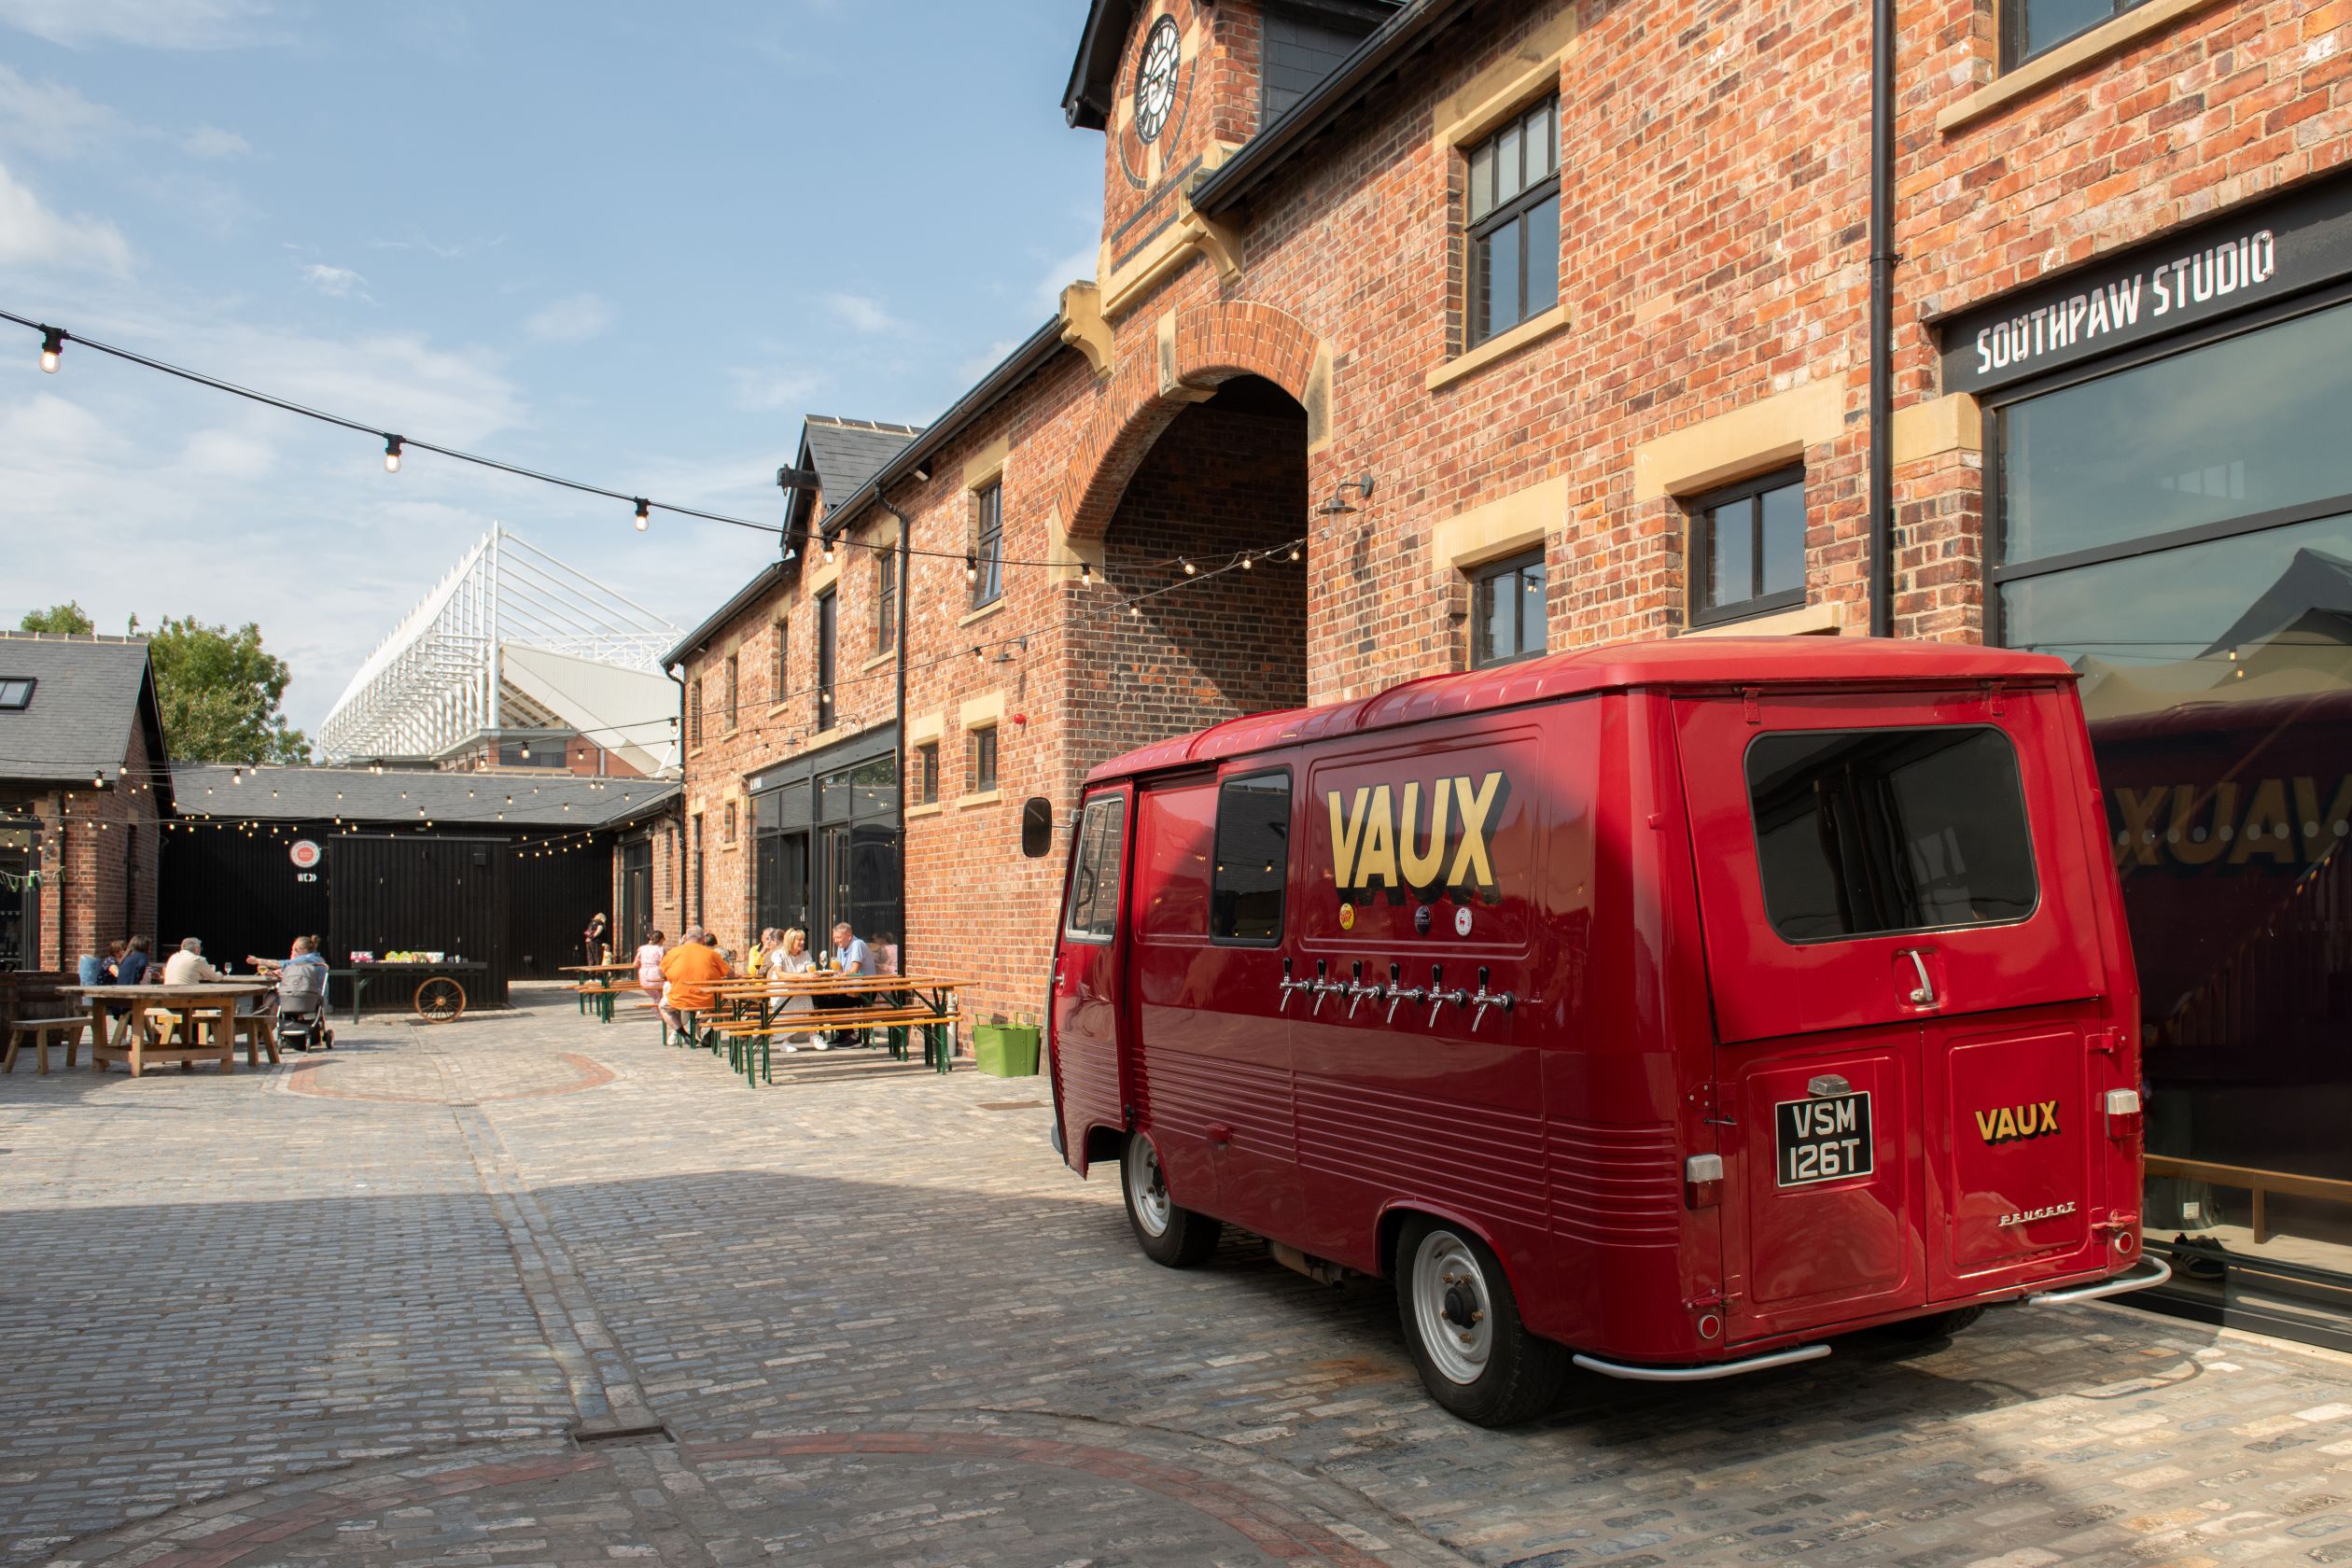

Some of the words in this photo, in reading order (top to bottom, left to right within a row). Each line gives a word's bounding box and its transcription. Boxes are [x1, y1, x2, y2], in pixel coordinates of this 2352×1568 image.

[1977, 273, 2142, 374] SOUTHPAW
[2152, 230, 2274, 316] STUDIO
[1328, 771, 1504, 889] VAUX
[1792, 1098, 1856, 1139] VSM
[1975, 1100, 2058, 1141] VAUX
[1790, 1138, 1860, 1180] 126T
[1998, 1201, 2077, 1226] PEUGEOT
